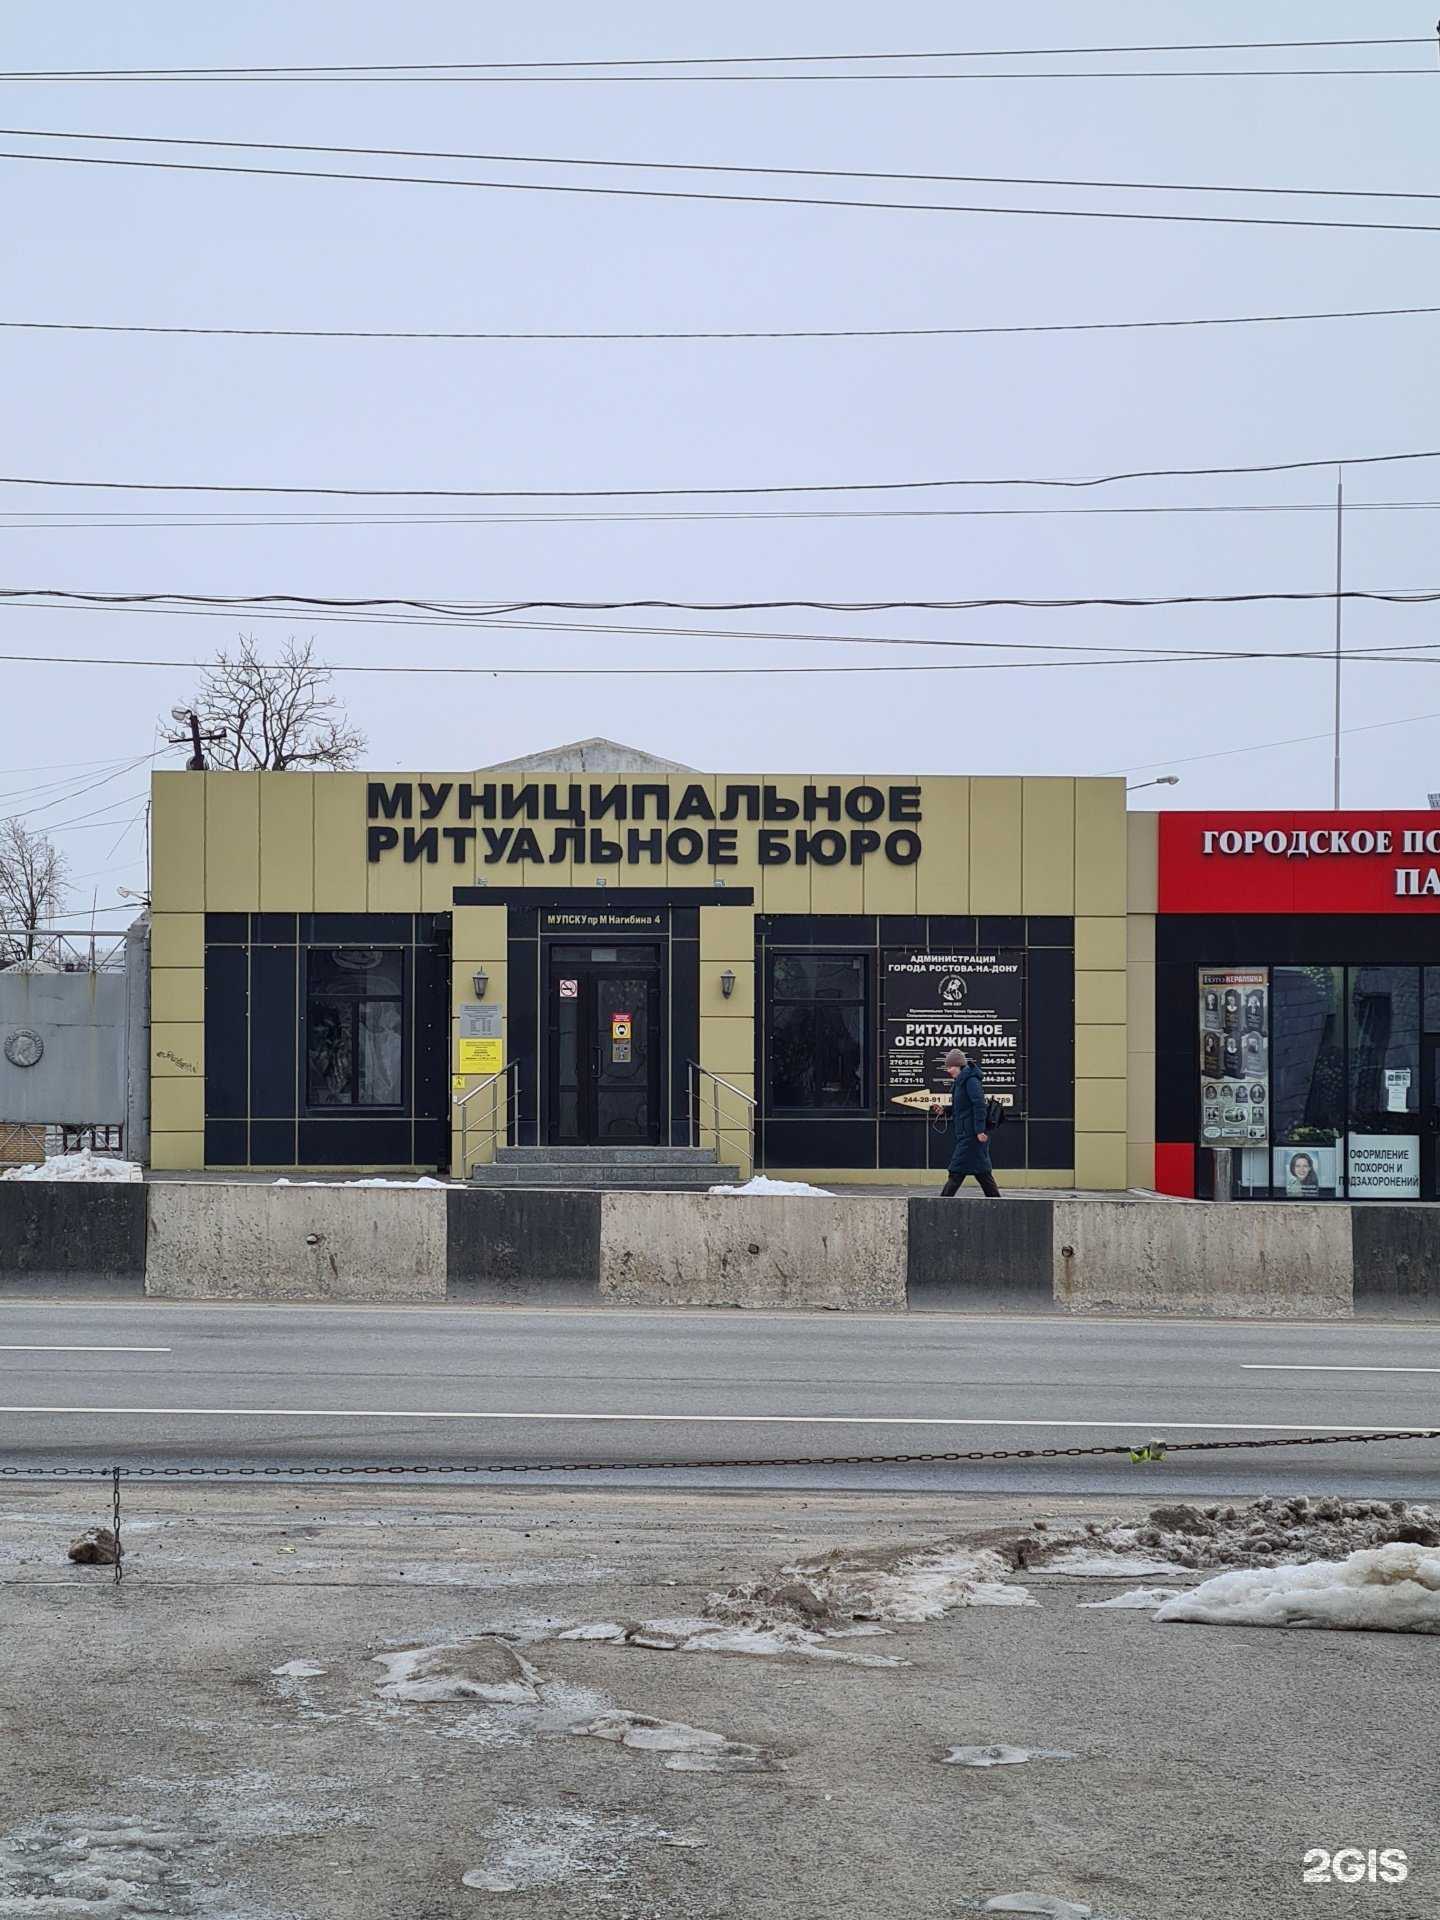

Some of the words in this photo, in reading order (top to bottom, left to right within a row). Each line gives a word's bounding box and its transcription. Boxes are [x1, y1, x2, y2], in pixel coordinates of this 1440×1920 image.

[367, 782, 923, 827] МУНИЦИПАЛЬНОЕ
[367, 826, 739, 865] РИТУАЛЬНОЕ
[758, 829, 923, 866] БЮРО
[1202, 829, 1393, 858] ГОРОДСКОЕ
[1394, 867, 1440, 896] ПА
[608, 914, 652, 925] Нагибина
[654, 914, 661, 925] 4
[910, 955, 996, 964] АДМИНИСТРАЦИЯ
[888, 964, 927, 973] ГОРОДА
[929, 964, 1018, 974] РОСТОВА-НА-ДОНУ
[906, 1024, 1003, 1036] РИТУАЛЬНОЕ
[895, 1036, 1018, 1048] ОБСЛУЖИВАНИЕ
[1349, 1149, 1409, 1160] ОФОРМЛЕНИЕ
[1354, 1163, 1395, 1173] ПОХОРОН
[1396, 1163, 1403, 1173] И
[1338, 1175, 1420, 1188] ПДЗАХОРОНЕНИЙ
